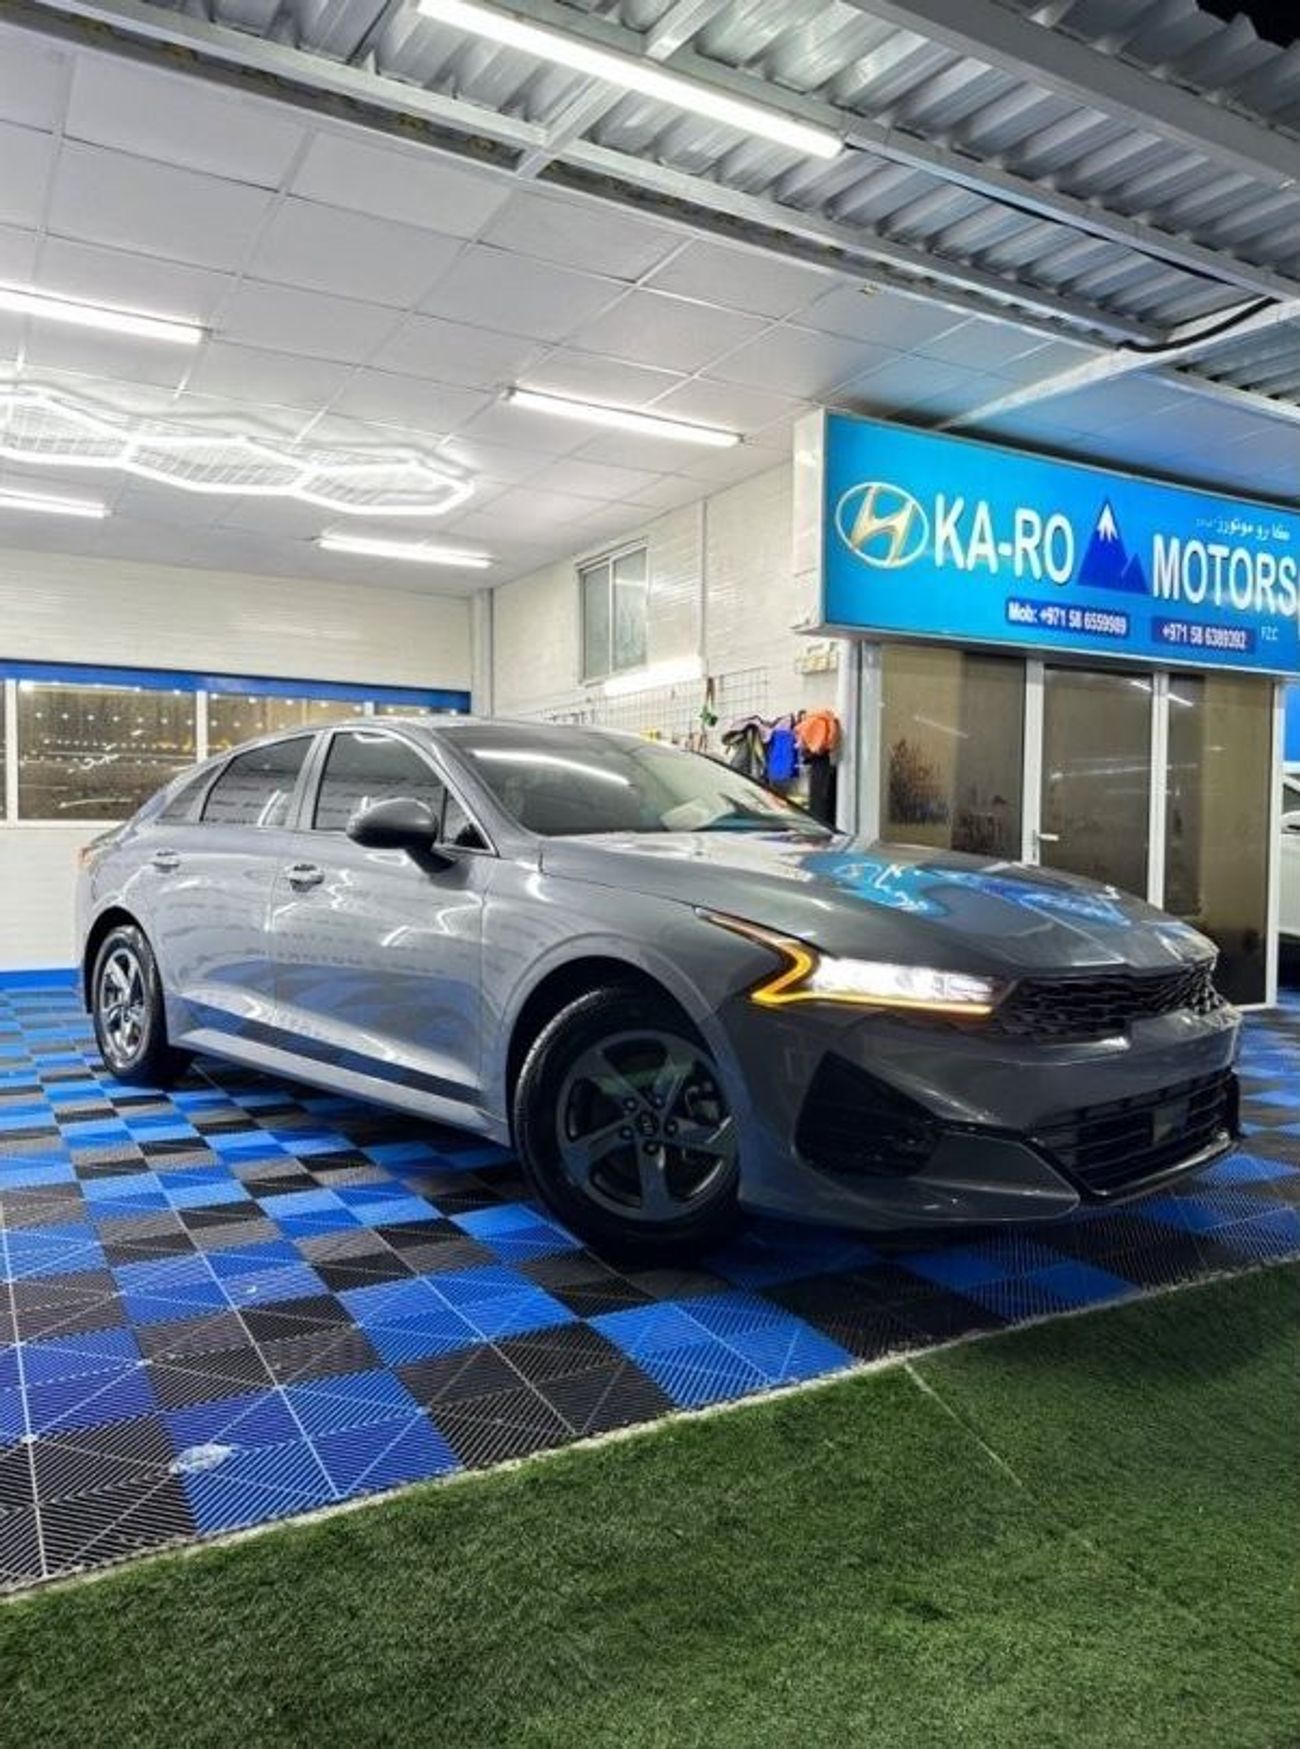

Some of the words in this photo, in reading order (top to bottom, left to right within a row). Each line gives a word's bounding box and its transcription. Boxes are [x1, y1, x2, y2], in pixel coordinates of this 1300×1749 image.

[934, 493, 1075, 584] KA-RO
[1152, 533, 1297, 617] MOTORS
[1007, 601, 1038, 624] Mob:
[1039, 606, 1067, 627] +971
[1161, 622, 1188, 643] +971
